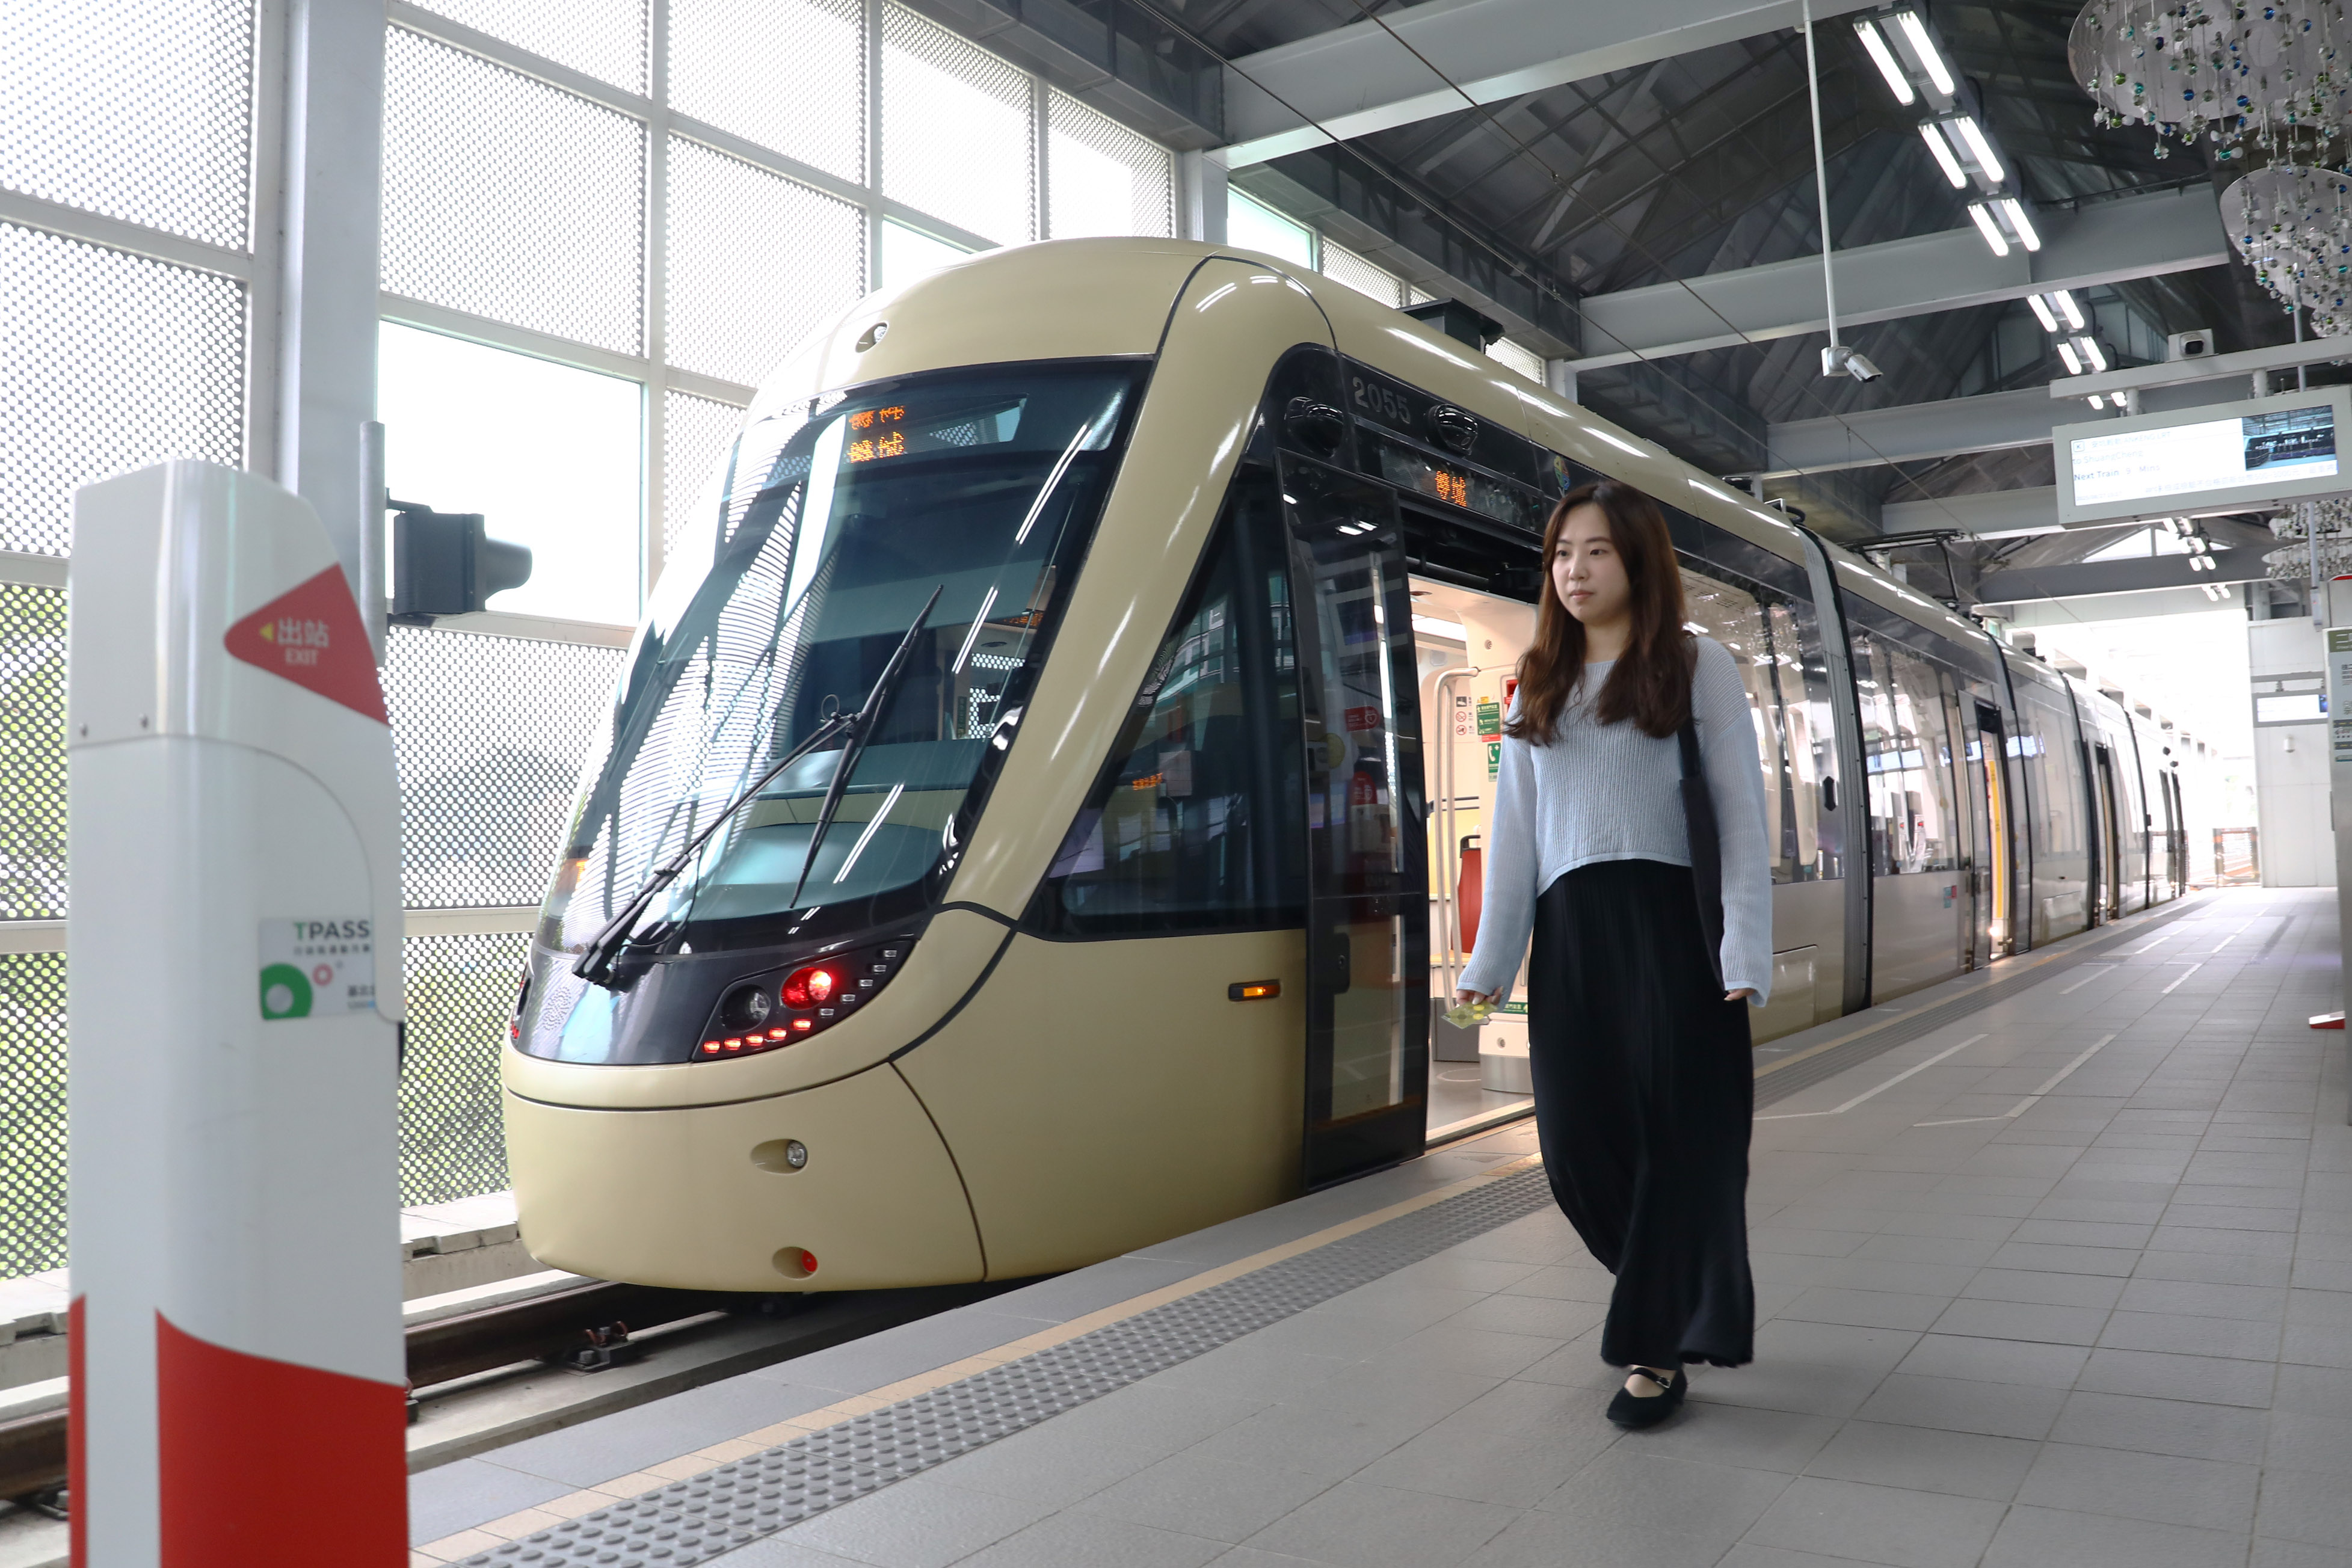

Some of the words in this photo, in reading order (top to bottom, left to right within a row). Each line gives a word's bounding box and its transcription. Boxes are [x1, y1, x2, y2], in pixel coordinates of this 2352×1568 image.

[1352, 377, 1411, 425] 2055
[2124, 433, 2155, 443] ANKENG
[2084, 450, 2144, 464] ShuangCheng
[2074, 472, 2095, 481] Next
[2096, 469, 2120, 478] Train
[277, 617, 329, 648] 出站
[286, 649, 318, 665] EXIT
[293, 920, 371, 940] TPASS
